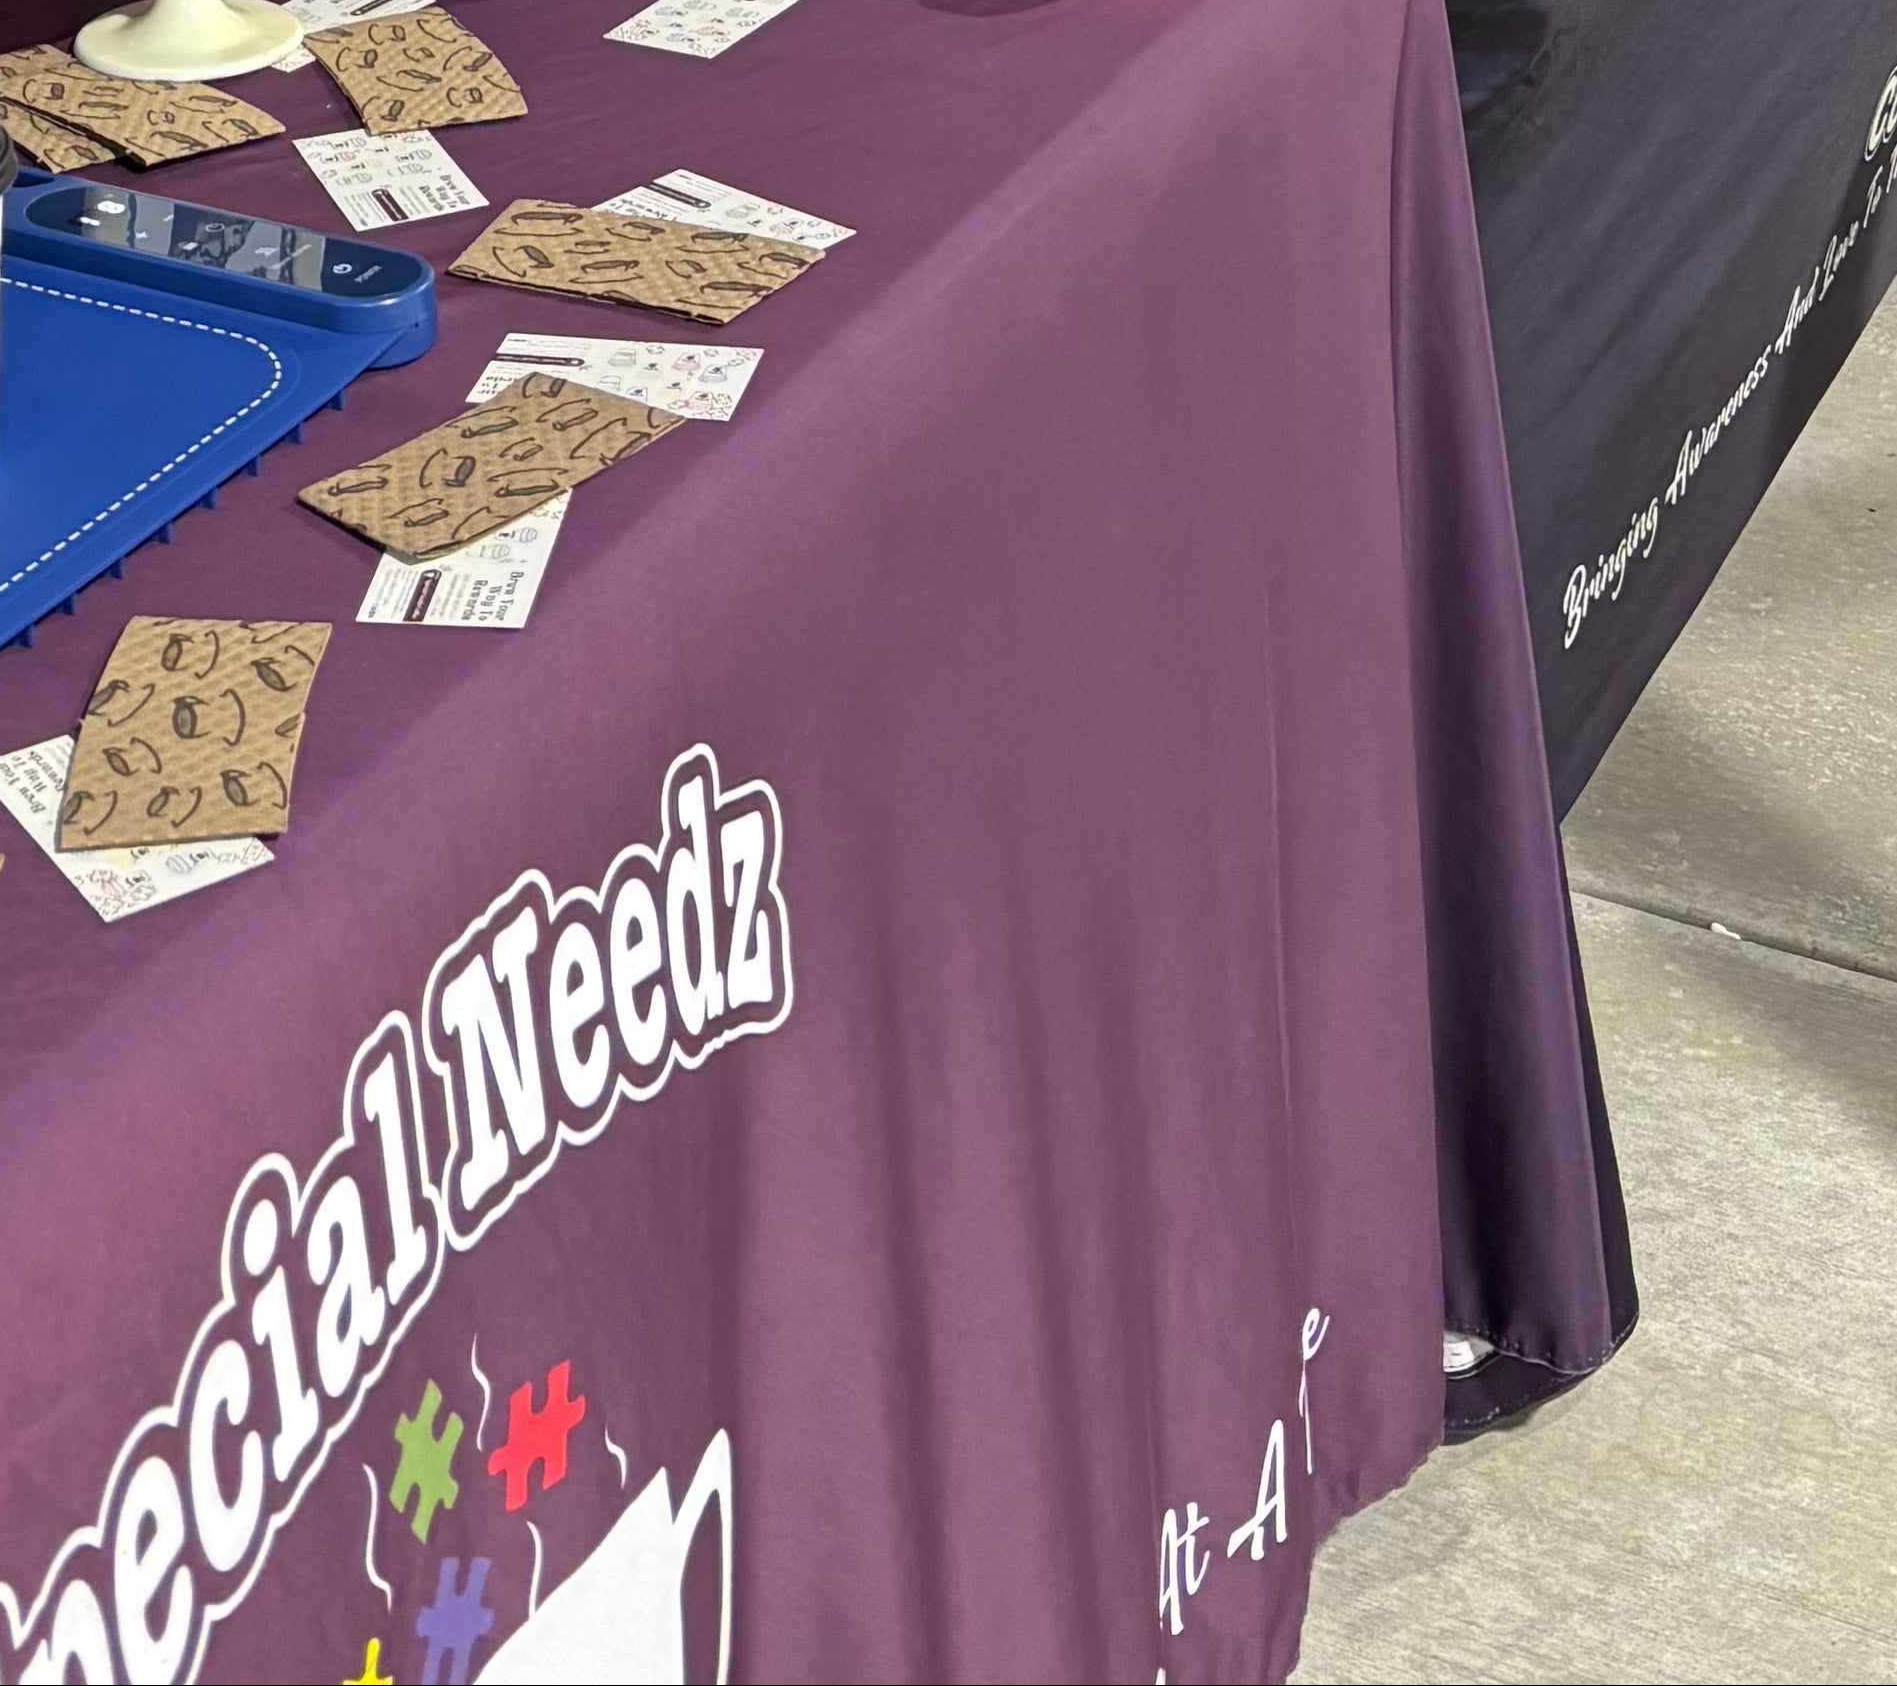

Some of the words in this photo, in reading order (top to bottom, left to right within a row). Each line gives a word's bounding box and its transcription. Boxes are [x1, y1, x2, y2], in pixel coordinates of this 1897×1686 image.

[1563, 496, 1659, 649] Bringing
[1665, 345, 1772, 504] Awareness
[1774, 266, 1820, 354] And
[425, 743, 794, 1250] Needz
